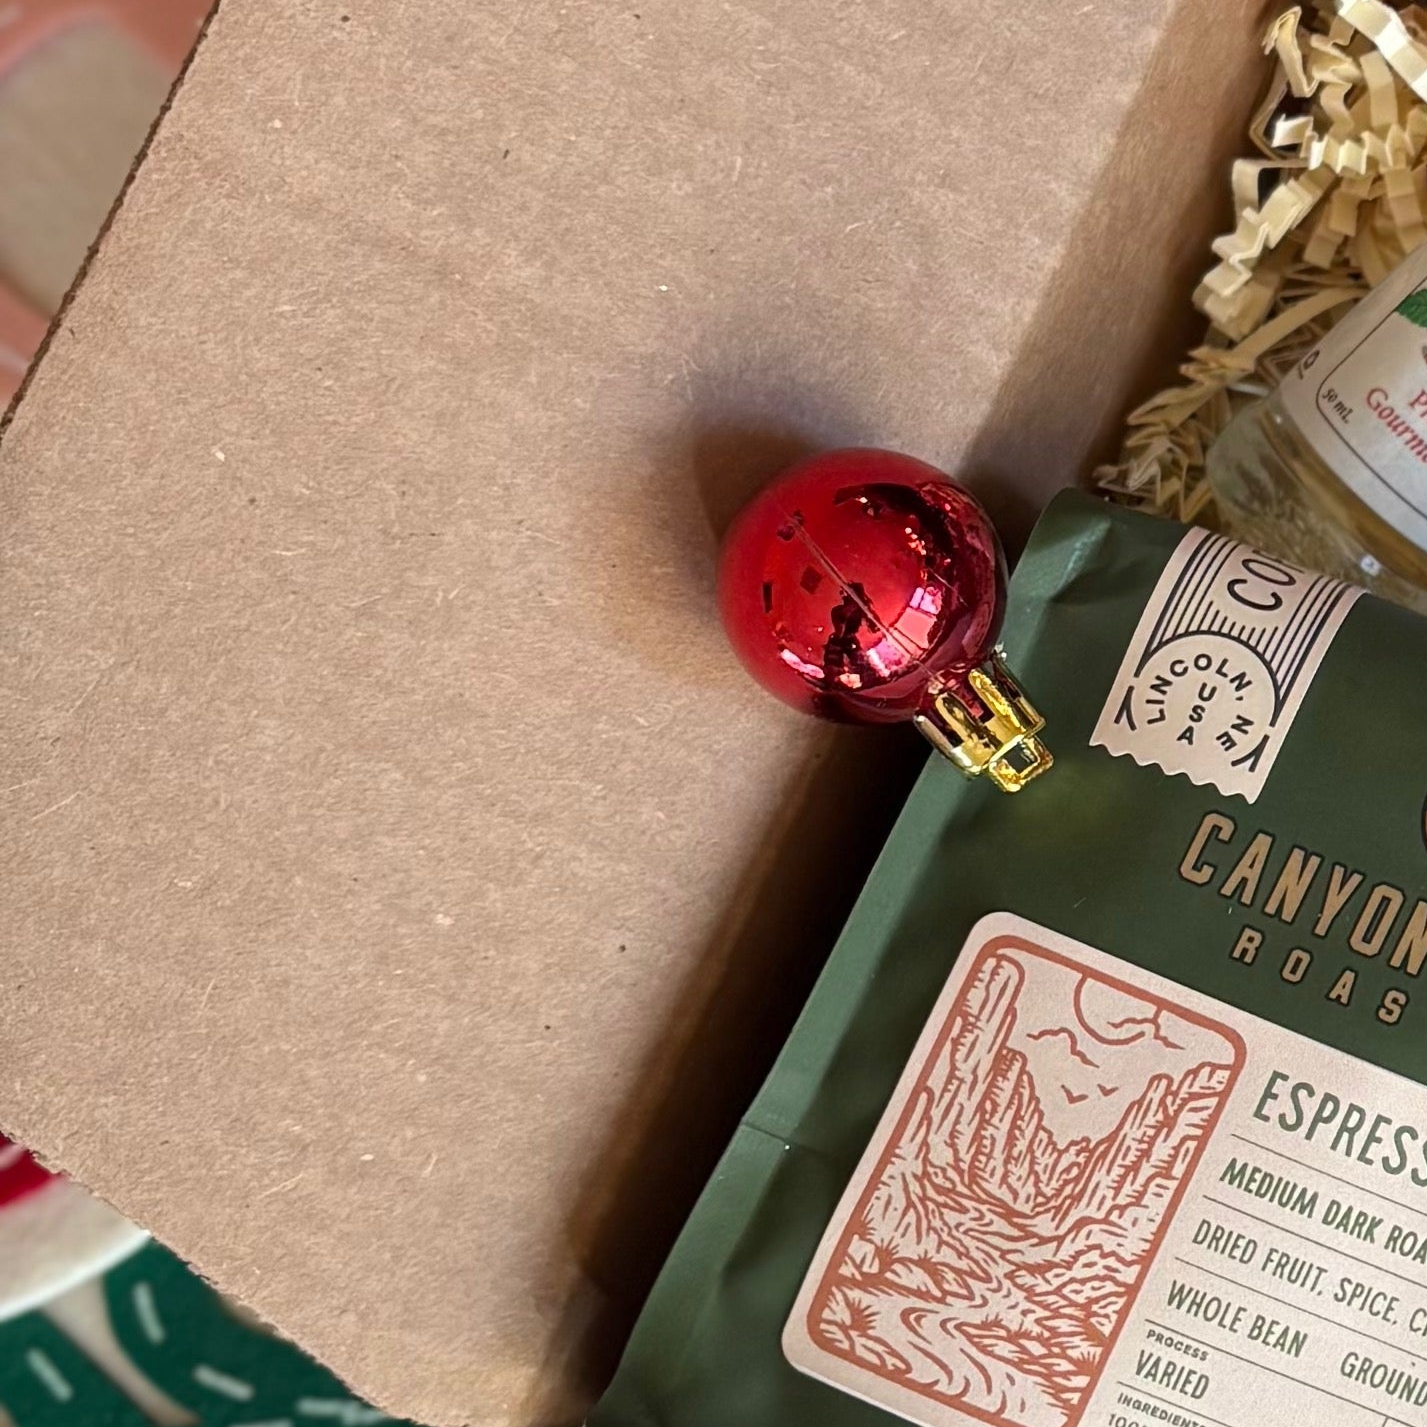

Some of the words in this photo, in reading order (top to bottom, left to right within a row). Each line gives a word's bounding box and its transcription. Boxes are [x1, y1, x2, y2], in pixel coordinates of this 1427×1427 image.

[1215, 714, 1255, 752] NE
[1219, 1158, 1319, 1219] MEDIUM
[1321, 1199, 1385, 1244] DARK
[1192, 1219, 1258, 1265] DRIED
[1166, 1279, 1247, 1333] WHOLE
[1247, 1314, 1309, 1359] BEAN
[1146, 1329, 1209, 1362] PROCESS
[1135, 1349, 1210, 1400] VARIED
